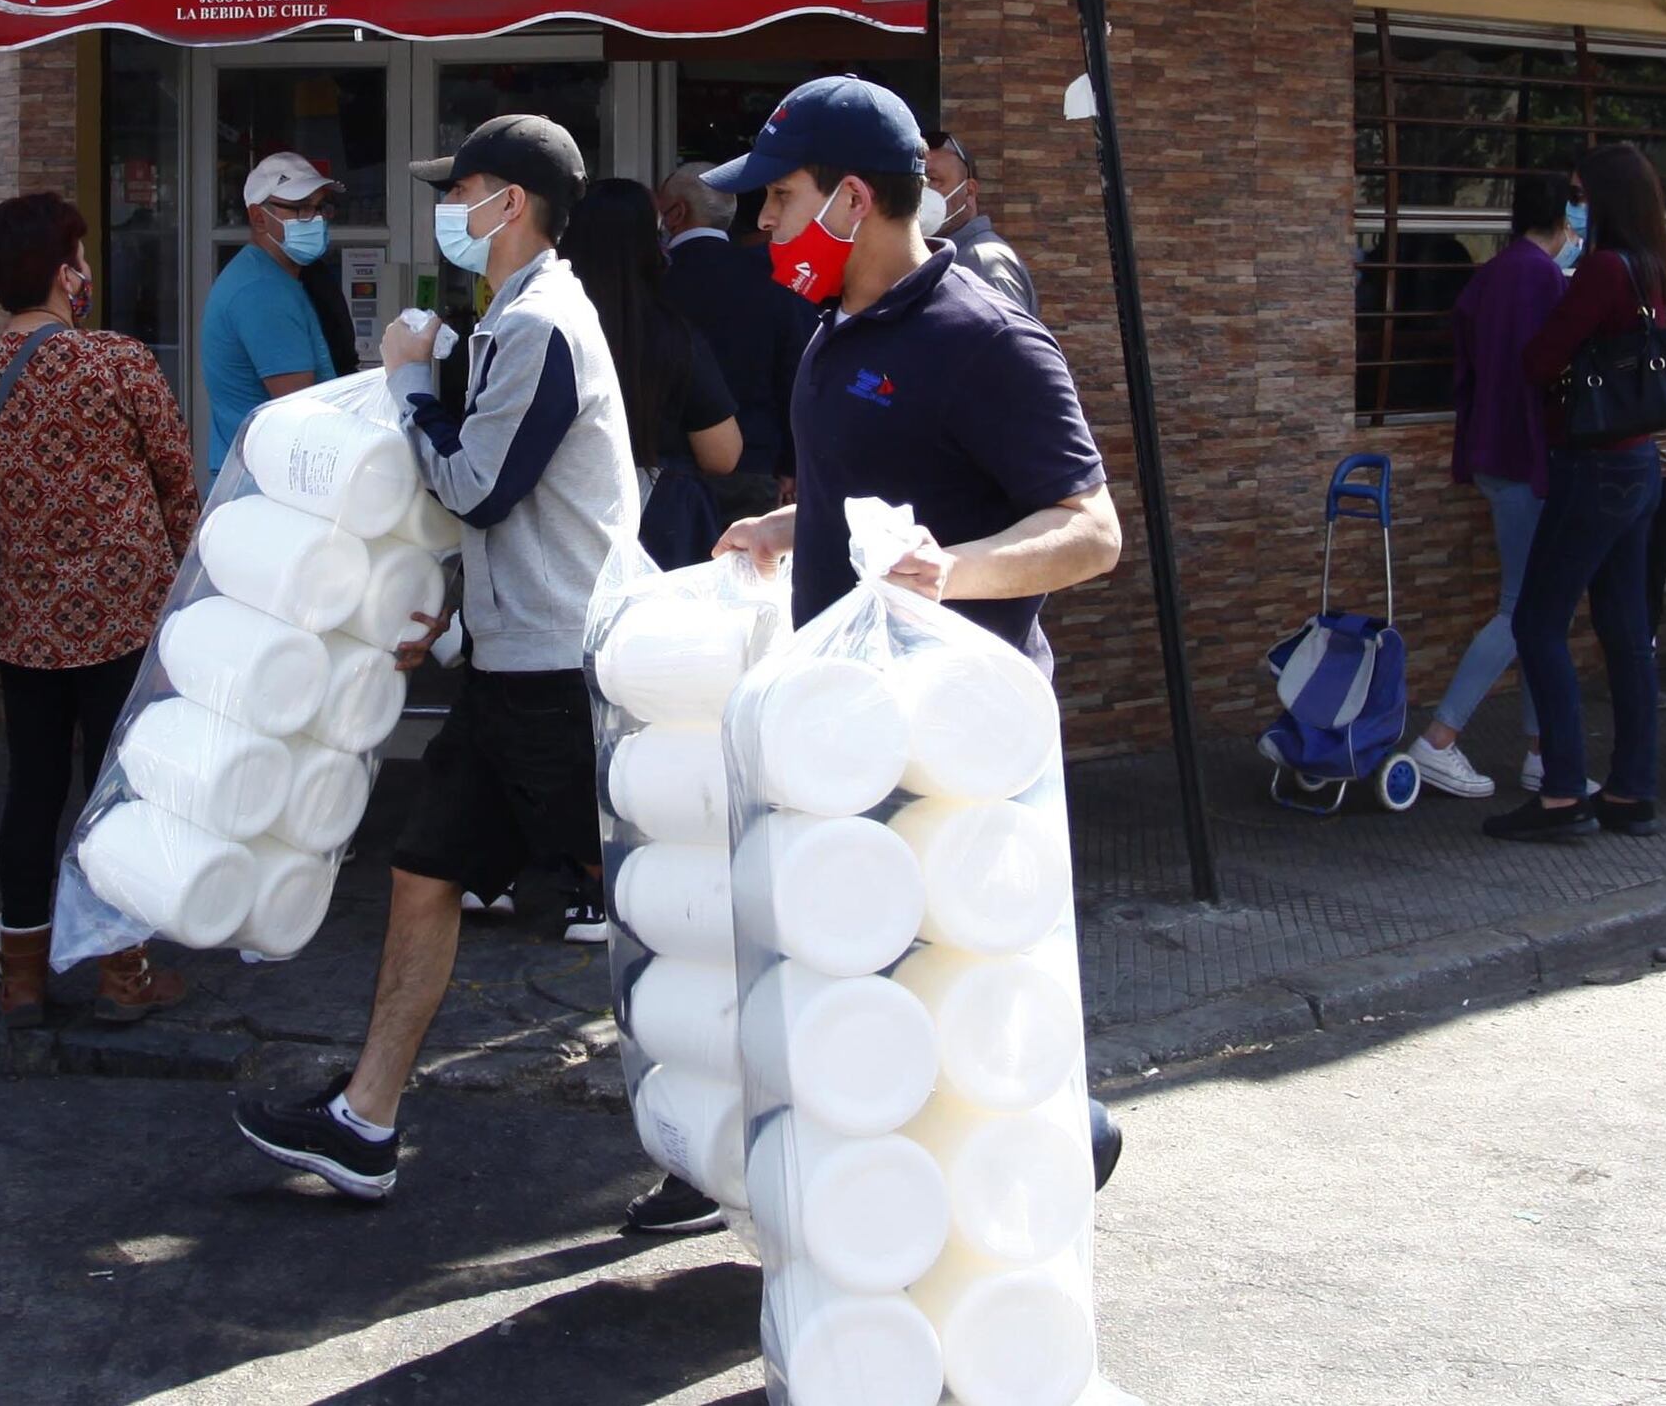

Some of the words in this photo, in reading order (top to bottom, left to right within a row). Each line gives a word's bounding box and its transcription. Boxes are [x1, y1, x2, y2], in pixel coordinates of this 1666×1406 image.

[176, 7, 197, 21] LA
[200, 5, 256, 20] BEBIDA
[257, 4, 277, 19] DE
[280, 3, 328, 18] CHILE
